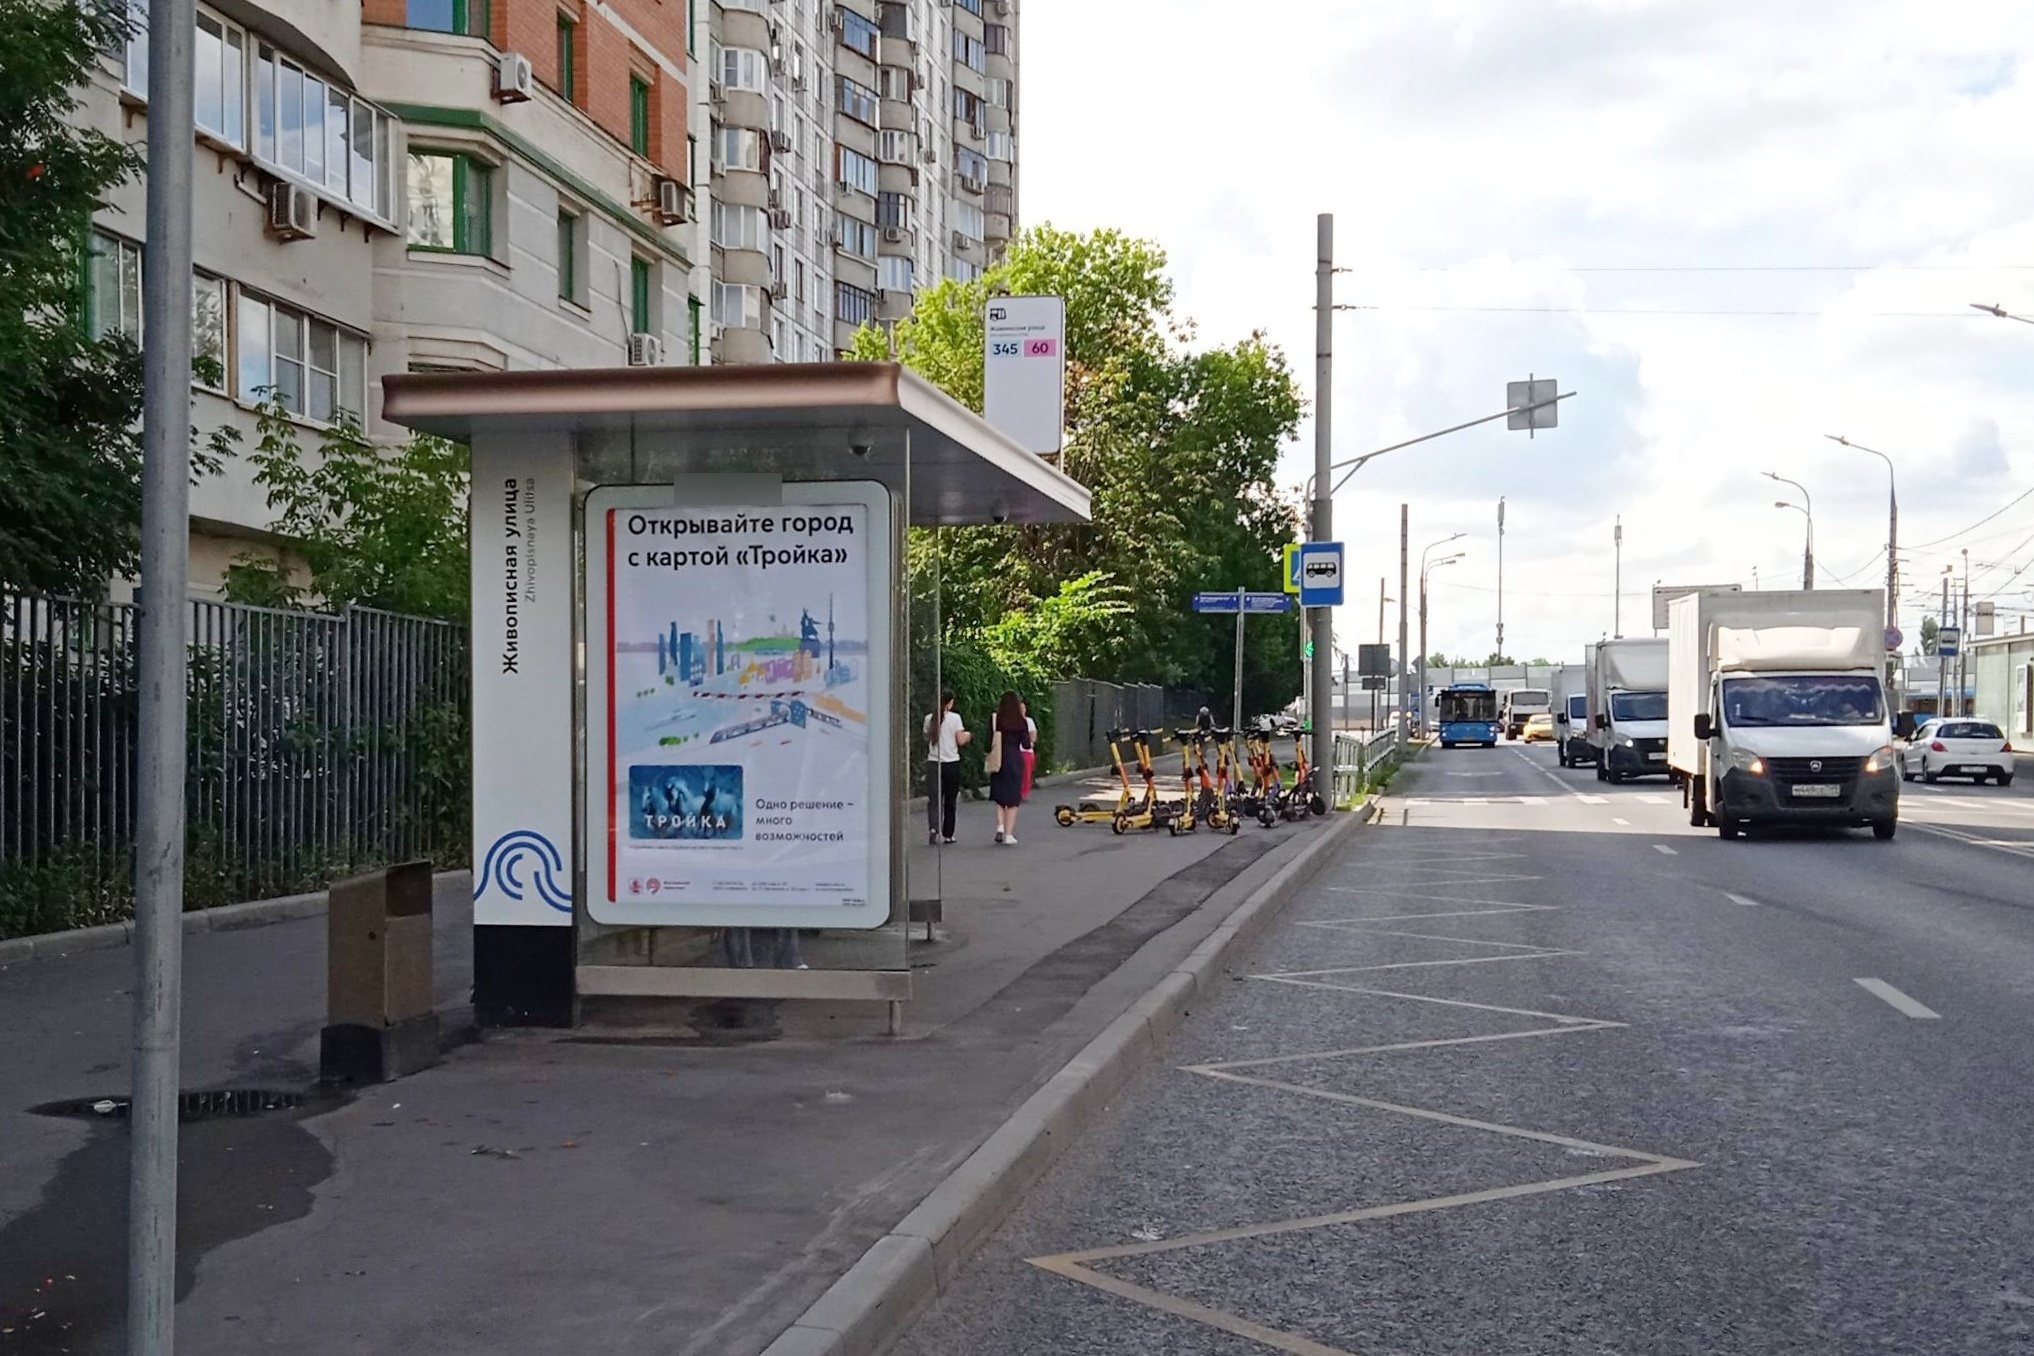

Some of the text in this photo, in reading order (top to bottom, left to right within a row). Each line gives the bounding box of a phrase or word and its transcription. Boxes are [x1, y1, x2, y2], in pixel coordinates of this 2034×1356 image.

[993, 342, 1048, 355] 345 60
[628, 514, 854, 539] Открывайте город
[525, 477, 538, 603] Zhivopisnaya Ulitsa
[628, 545, 848, 570] с картой «Тройка»
[502, 478, 521, 675] Живописная улица
[755, 798, 786, 811] Одно
[790, 801, 844, 812] решение
[644, 813, 728, 829] ТРОЙКА
[755, 816, 793, 827] много
[755, 831, 844, 843] возможностей
